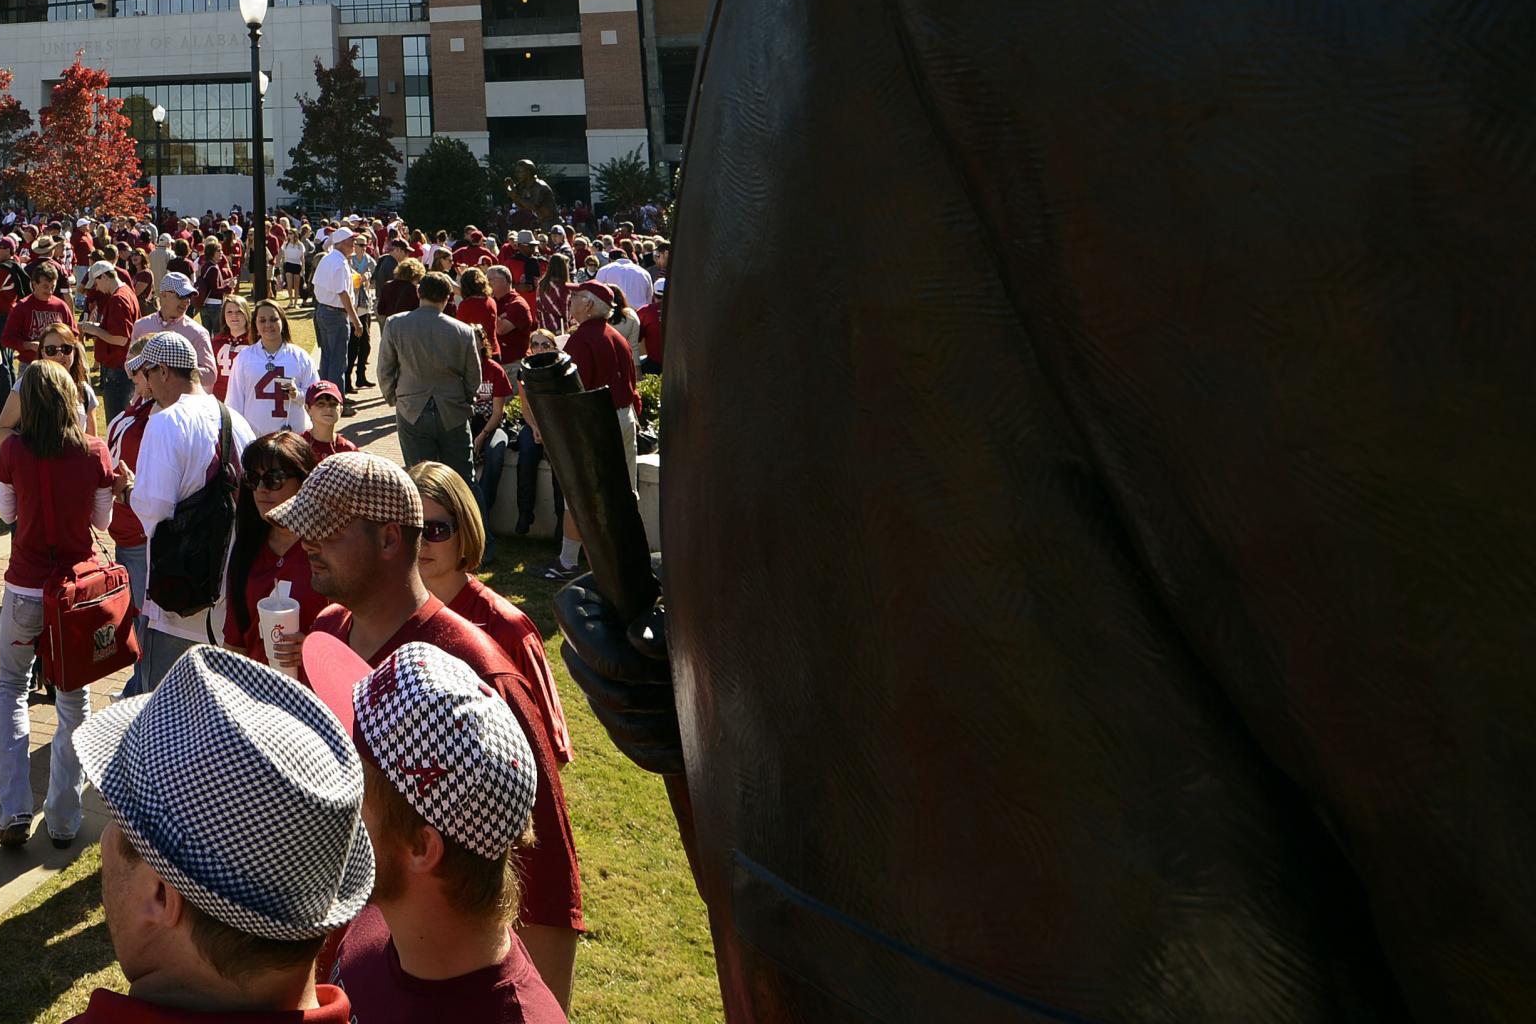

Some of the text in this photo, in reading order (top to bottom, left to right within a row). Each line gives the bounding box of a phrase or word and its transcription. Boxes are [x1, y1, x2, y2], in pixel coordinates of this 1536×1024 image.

[42, 37, 144, 56] UNIVERSITY
[150, 36, 172, 49] OF
[254, 366, 290, 418] 4
